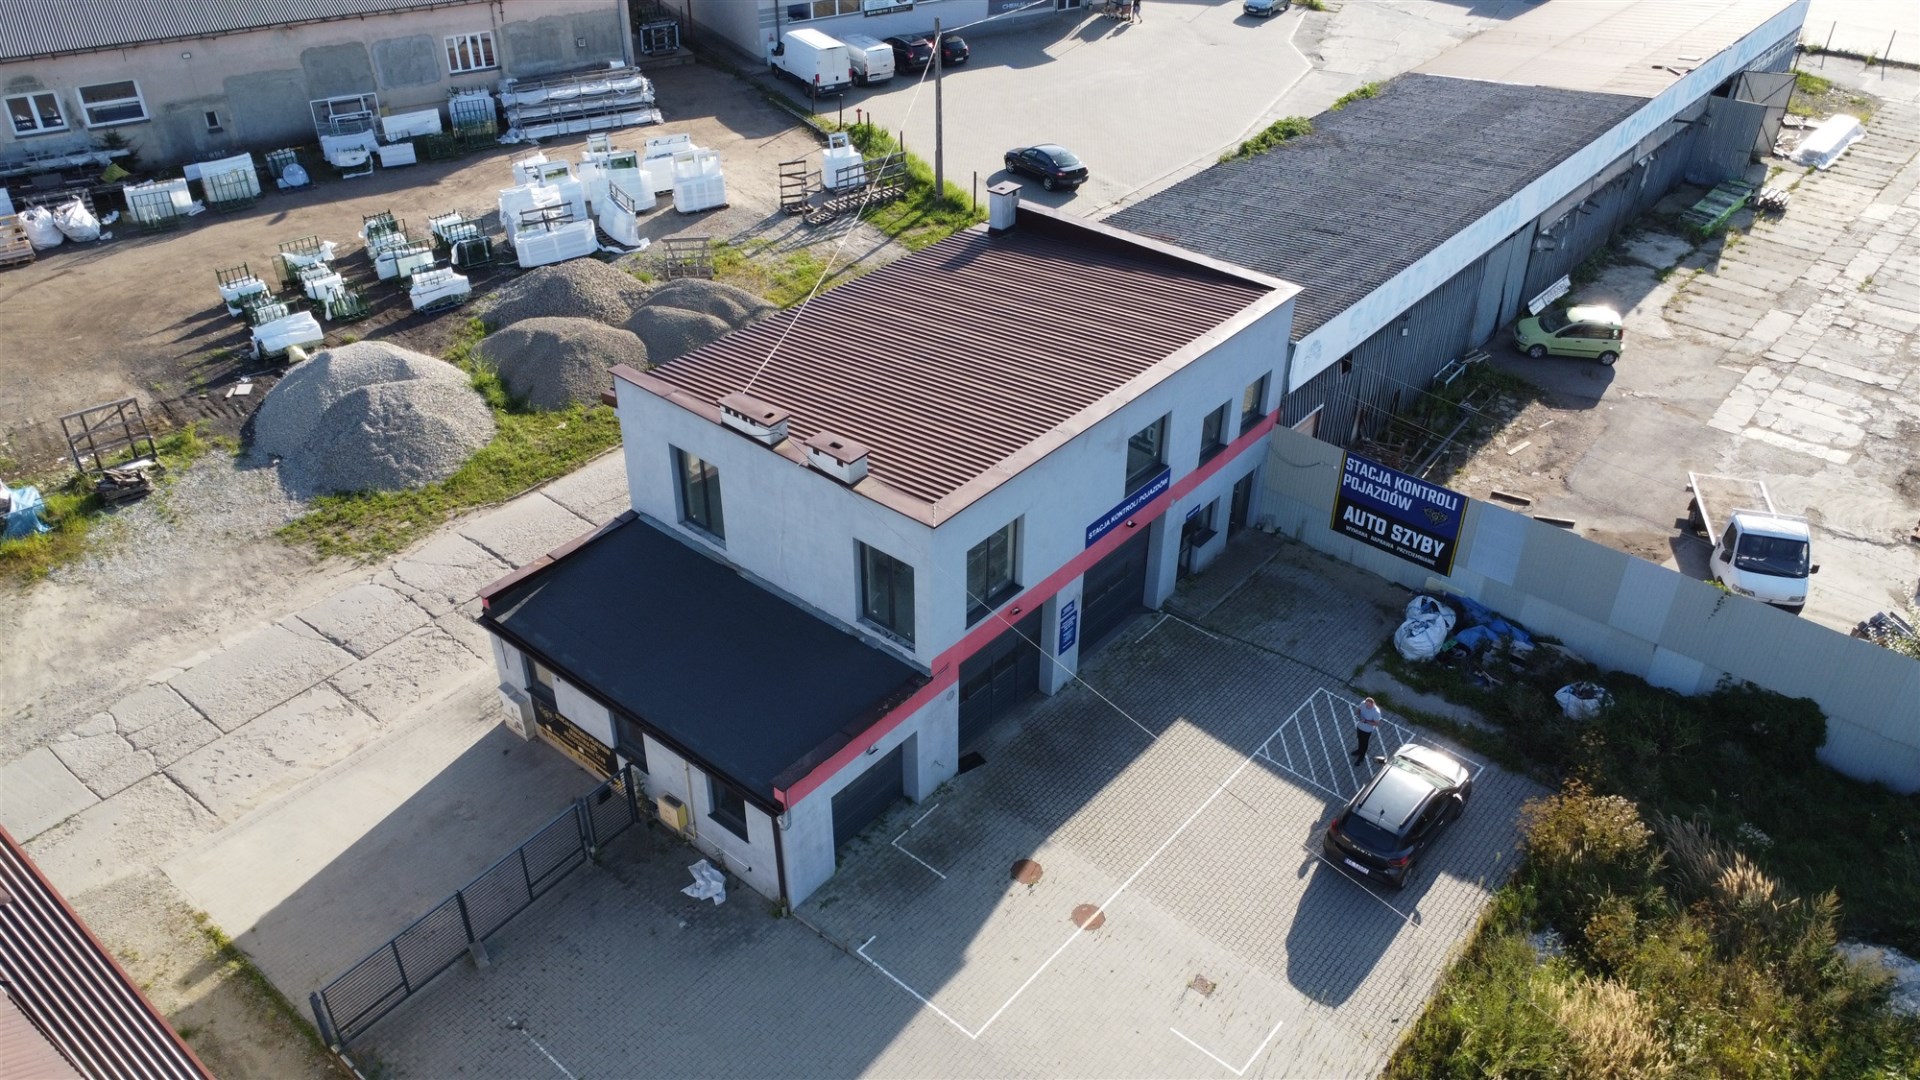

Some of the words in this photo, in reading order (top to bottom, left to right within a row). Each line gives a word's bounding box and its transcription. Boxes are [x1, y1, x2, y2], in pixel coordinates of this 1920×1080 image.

[1088, 519, 1111, 540] STACJA
[1110, 499, 1139, 523] KONTROLI
[1138, 477, 1168, 504] POJAZDÓW
[1342, 473, 1413, 512] POJAZDÓW
[1346, 457, 1391, 487] STACJA
[1394, 476, 1458, 511] KONTROLI
[1343, 505, 1388, 536] AUTO
[1391, 524, 1445, 558] SZYBY
